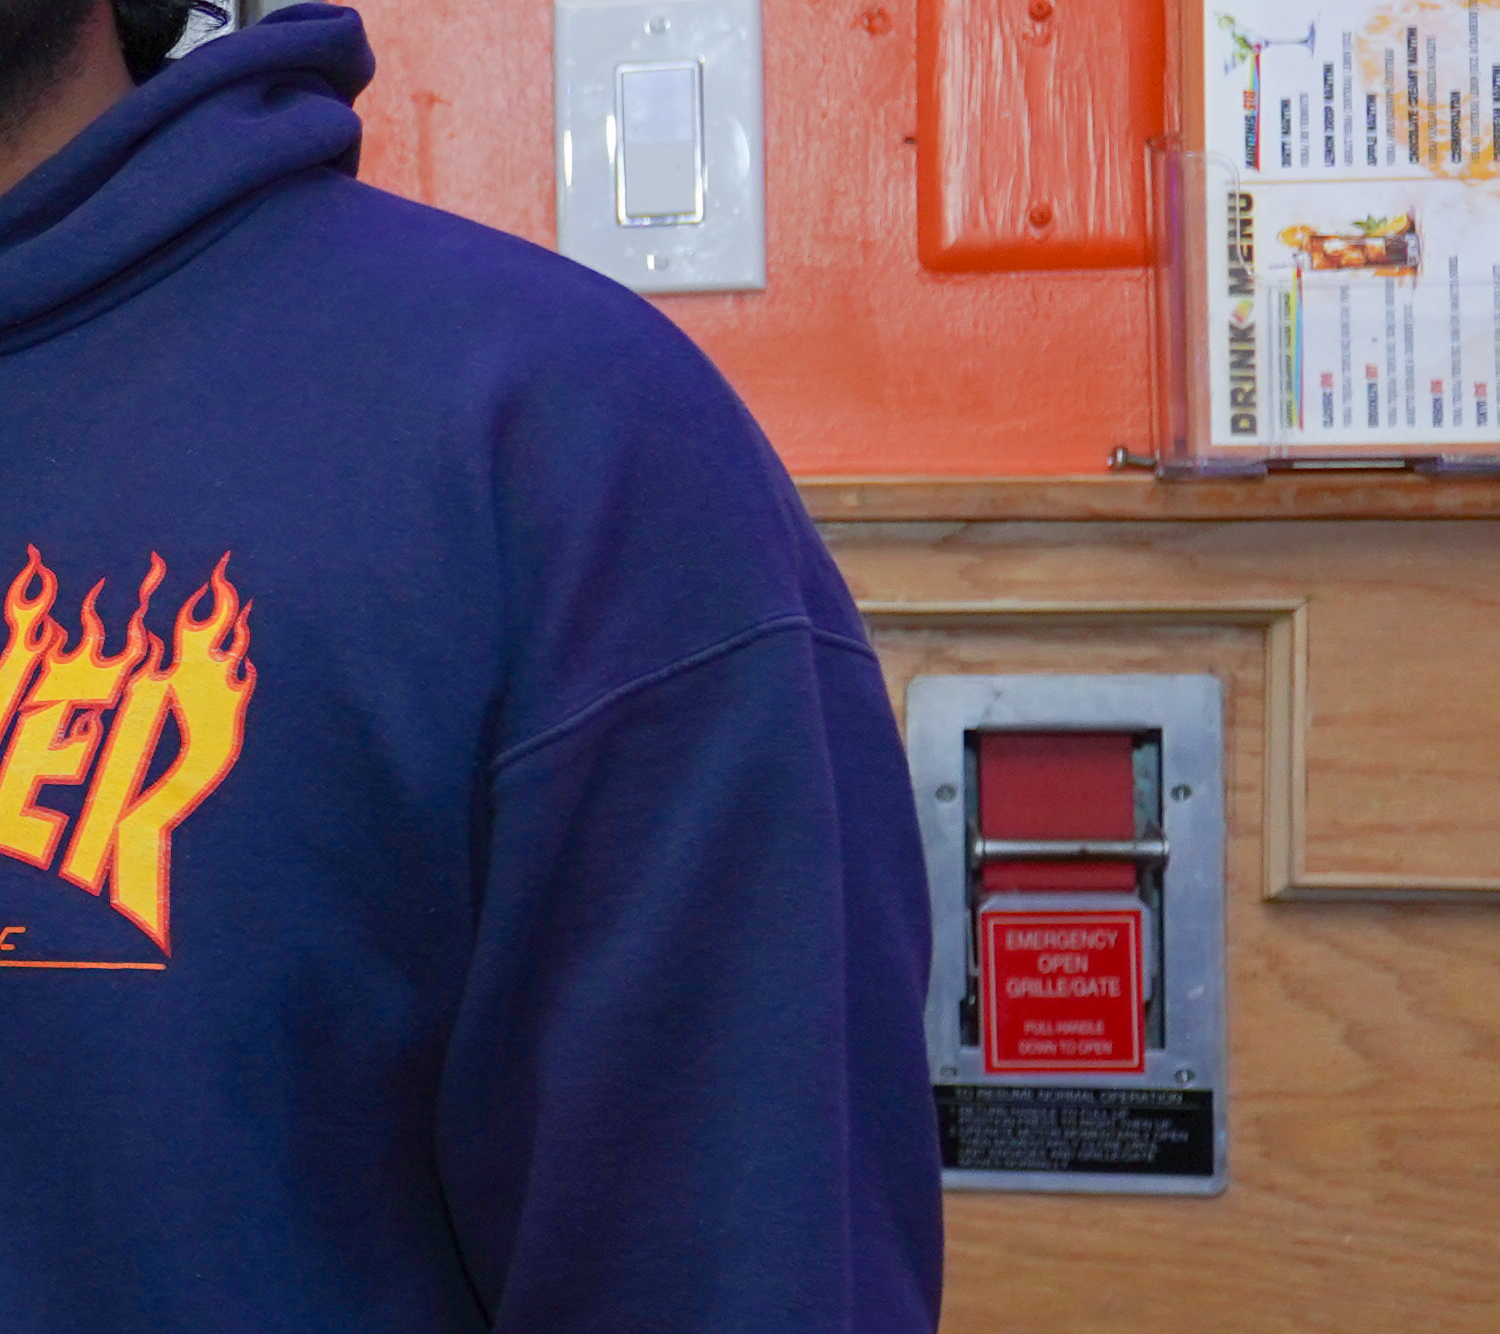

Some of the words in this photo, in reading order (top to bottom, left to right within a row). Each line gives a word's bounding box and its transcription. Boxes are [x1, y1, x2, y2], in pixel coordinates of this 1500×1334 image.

[1407, 27, 1418, 65] MARTINI
[1323, 62, 1334, 103] MARTINI
[1280, 99, 1290, 137] MARTINI
[1324, 106, 1334, 132] DROP
[1366, 94, 1376, 131] MARTINI
[1451, 91, 1460, 164] COSMOPOLITAN
[1245, 115, 1256, 169] MARTINIS
[1324, 135, 1335, 167] LEMON
[1408, 111, 1419, 164] CHOCOLATE
[1227, 193, 1256, 297] MENU
[1228, 322, 1256, 435] DRINK
[1005, 929, 1118, 951] EMERGENCY
[1037, 952, 1089, 974] OPEN
[1005, 976, 1121, 998] GRILLE/GATE
[1018, 1039, 1057, 1055] DOWN
[1060, 1039, 1077, 1055] TO
[1078, 1039, 1112, 1055] OPEN
